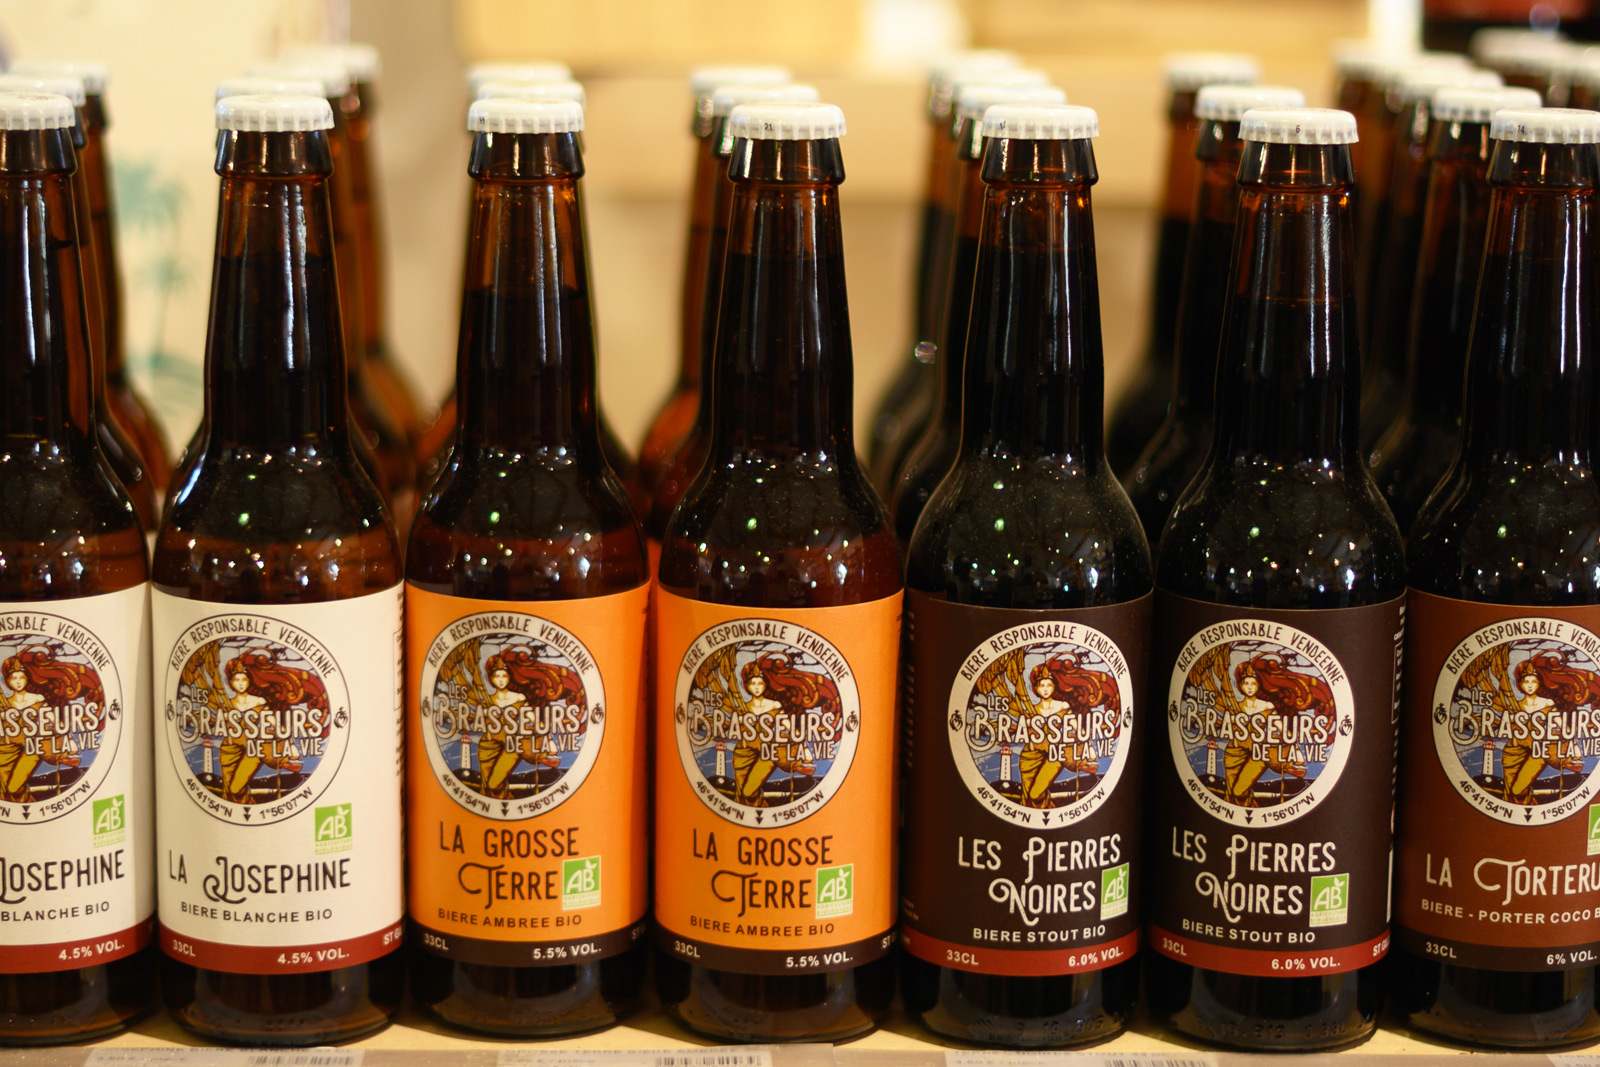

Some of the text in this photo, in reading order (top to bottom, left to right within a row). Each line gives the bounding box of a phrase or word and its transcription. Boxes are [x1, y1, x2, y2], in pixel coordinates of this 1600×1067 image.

[57, 621, 111, 672] VENDEENNE
[171, 618, 337, 679] BIERE RESPONSABLE VENDEENNE
[429, 616, 594, 676] BIERE RESPONSABLE VENDEENNE
[683, 622, 849, 683] BIERE RESPONSABLE VENDEENNE
[961, 624, 1127, 682] BIERE RESPONSABLE VENDEENNE
[1178, 622, 1344, 687] BIERE RESPONSABLE VENDEENNE
[1446, 643, 1475, 675] BIERE
[1475, 620, 1564, 647] RESPONSABLE
[190, 686, 209, 704] LES
[448, 682, 468, 700] LES
[703, 689, 723, 707] LES
[988, 694, 1010, 711] LES
[1196, 688, 1216, 706] LES
[1471, 688, 1493, 706] LES
[176, 697, 323, 743] BRASSEURS
[433, 692, 580, 739] BRASSEURS
[687, 700, 836, 747] BRASSEURS
[1179, 698, 1328, 744] BRASSEURS
[965, 705, 1116, 752] BRASSEURS
[25, 730, 101, 756] DE LA VIE
[246, 737, 323, 758] DE LA VIE
[506, 732, 580, 753] DE LA VIE
[761, 740, 836, 761] DE LA VIE
[1048, 738, 1115, 762] DE LA VIE
[1252, 743, 1328, 762] DE LA VIE
[1532, 741, 1550, 759] DE
[1557, 740, 1575, 758] LA
[95, 808, 122, 834] AB
[318, 816, 347, 841] AB
[440, 821, 579, 859] LA GROSSE
[693, 828, 833, 867] LA GROSSE
[958, 833, 1121, 884] LES PIERRES
[1172, 826, 1336, 880] LES PIERRES
[169, 849, 351, 904] LA JOSEPHINE
[566, 869, 595, 894] AB
[1426, 853, 1453, 888] LA
[459, 862, 558, 910] TERRE
[711, 869, 812, 918] TERRE
[819, 876, 848, 902] AB
[1103, 876, 1125, 904] AB
[1195, 871, 1303, 923] NOIRES
[1314, 886, 1342, 910] AB
[1, 901, 110, 923] BLANCHE BIO
[181, 901, 333, 923] BIERE BLANCHE BIO
[988, 877, 1097, 927] NOIRES
[1421, 898, 1463, 918] BIERE
[1478, 910, 1546, 924] PORTER
[1550, 909, 1591, 924] COCO
[438, 908, 582, 928] BIERE AMBREE BIO
[690, 915, 835, 937] BIERE AMBREE BIO
[424, 932, 449, 951] 33CL
[973, 924, 1106, 943] BIERE STOUT BIO
[1182, 918, 1315, 944] BIERE STOUT BIO
[58, 938, 125, 961] 4.5% VOL.
[172, 938, 196, 957] 33CL
[277, 947, 350, 965] 4.5% VOL.
[533, 942, 602, 960] 5.5% VOL.
[674, 940, 701, 958] 33CL
[946, 949, 979, 966] 33CL
[1068, 946, 1124, 968] 6.0% VOL.
[1162, 938, 1187, 956] 33CL
[1425, 941, 1457, 959] 33CL
[1546, 950, 1597, 965] 6% VOL.
[785, 951, 854, 968] 5.5% VOL.
[1271, 956, 1341, 971] 6.0% VOL.
